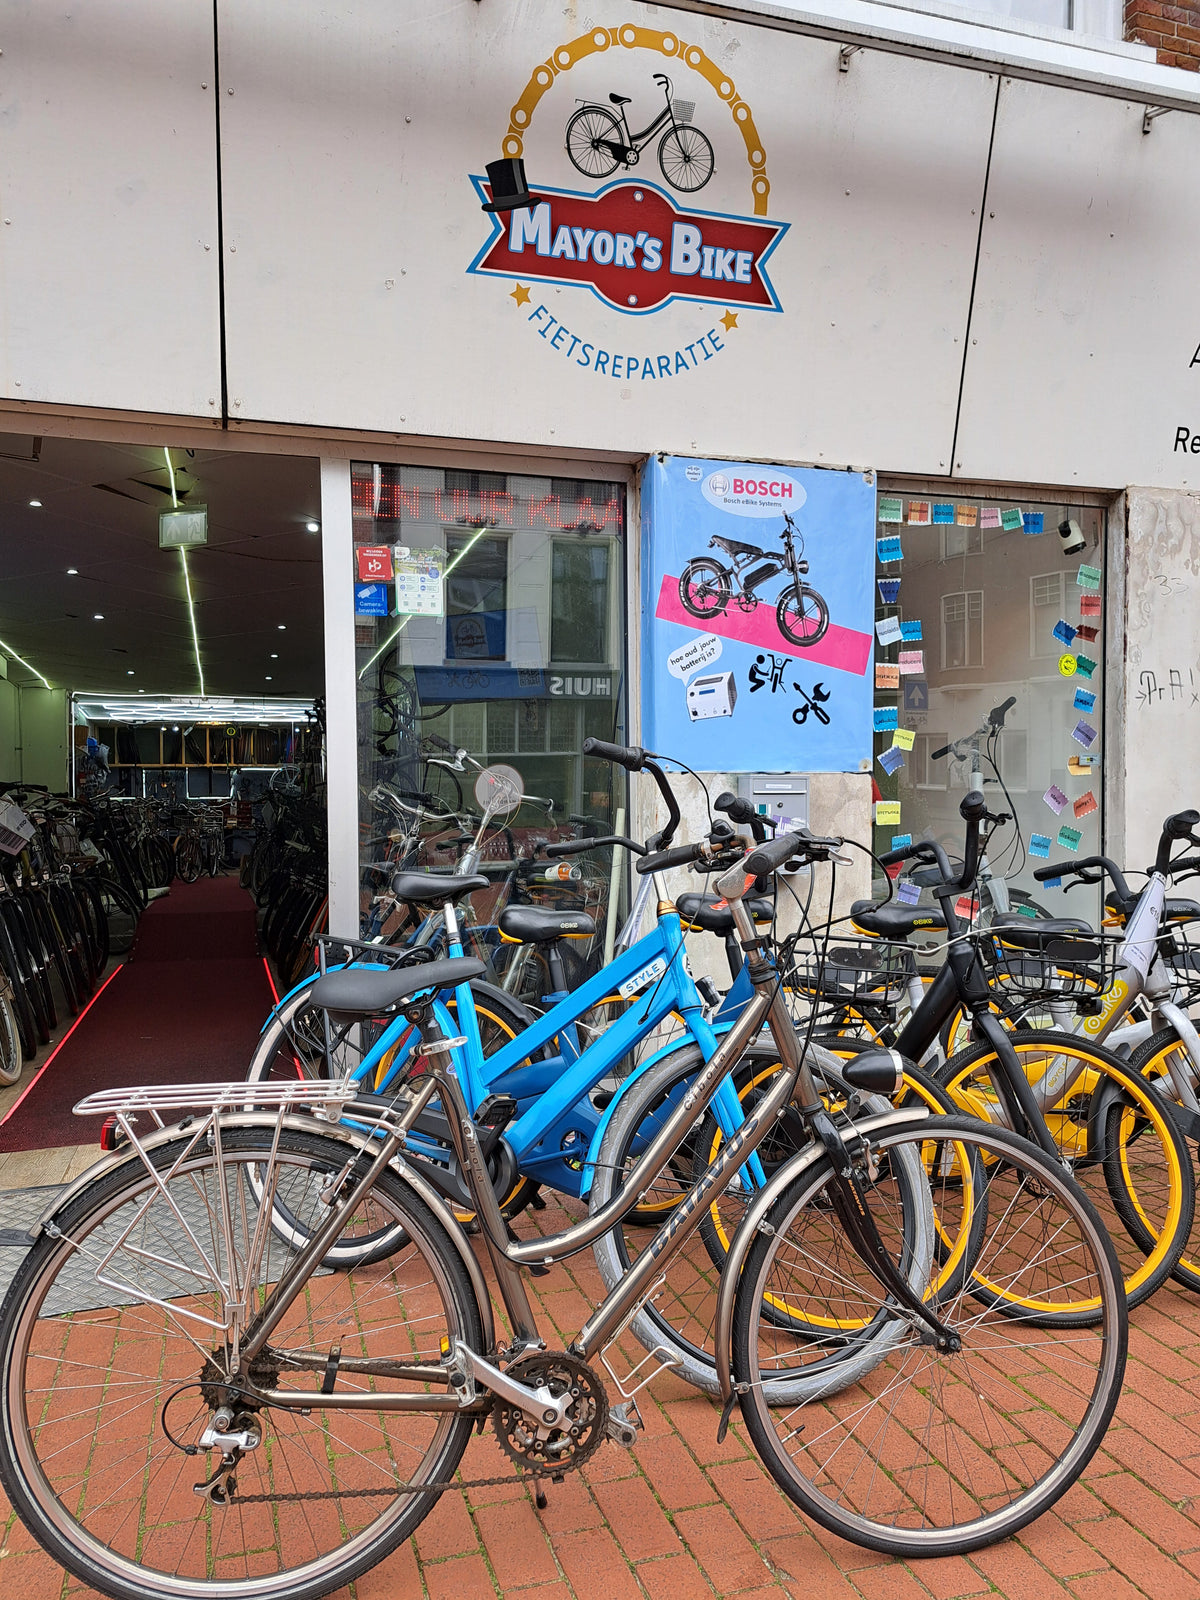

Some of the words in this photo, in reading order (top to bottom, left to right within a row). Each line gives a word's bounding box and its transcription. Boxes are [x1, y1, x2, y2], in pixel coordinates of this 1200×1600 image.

[528, 304, 725, 380] FIETSREPARATIE
[723, 497, 741, 505] Bosch
[758, 500, 782, 508] Systems
[733, 478, 793, 499] BOSCH
[670, 655, 684, 666] hoe
[684, 645, 698, 658] oud
[699, 636, 717, 652] jouw
[680, 653, 707, 672] batterij
[706, 647, 716, 658] is?
[625, 962, 660, 993] STYLE
[650, 1118, 760, 1260] BATAVUS
